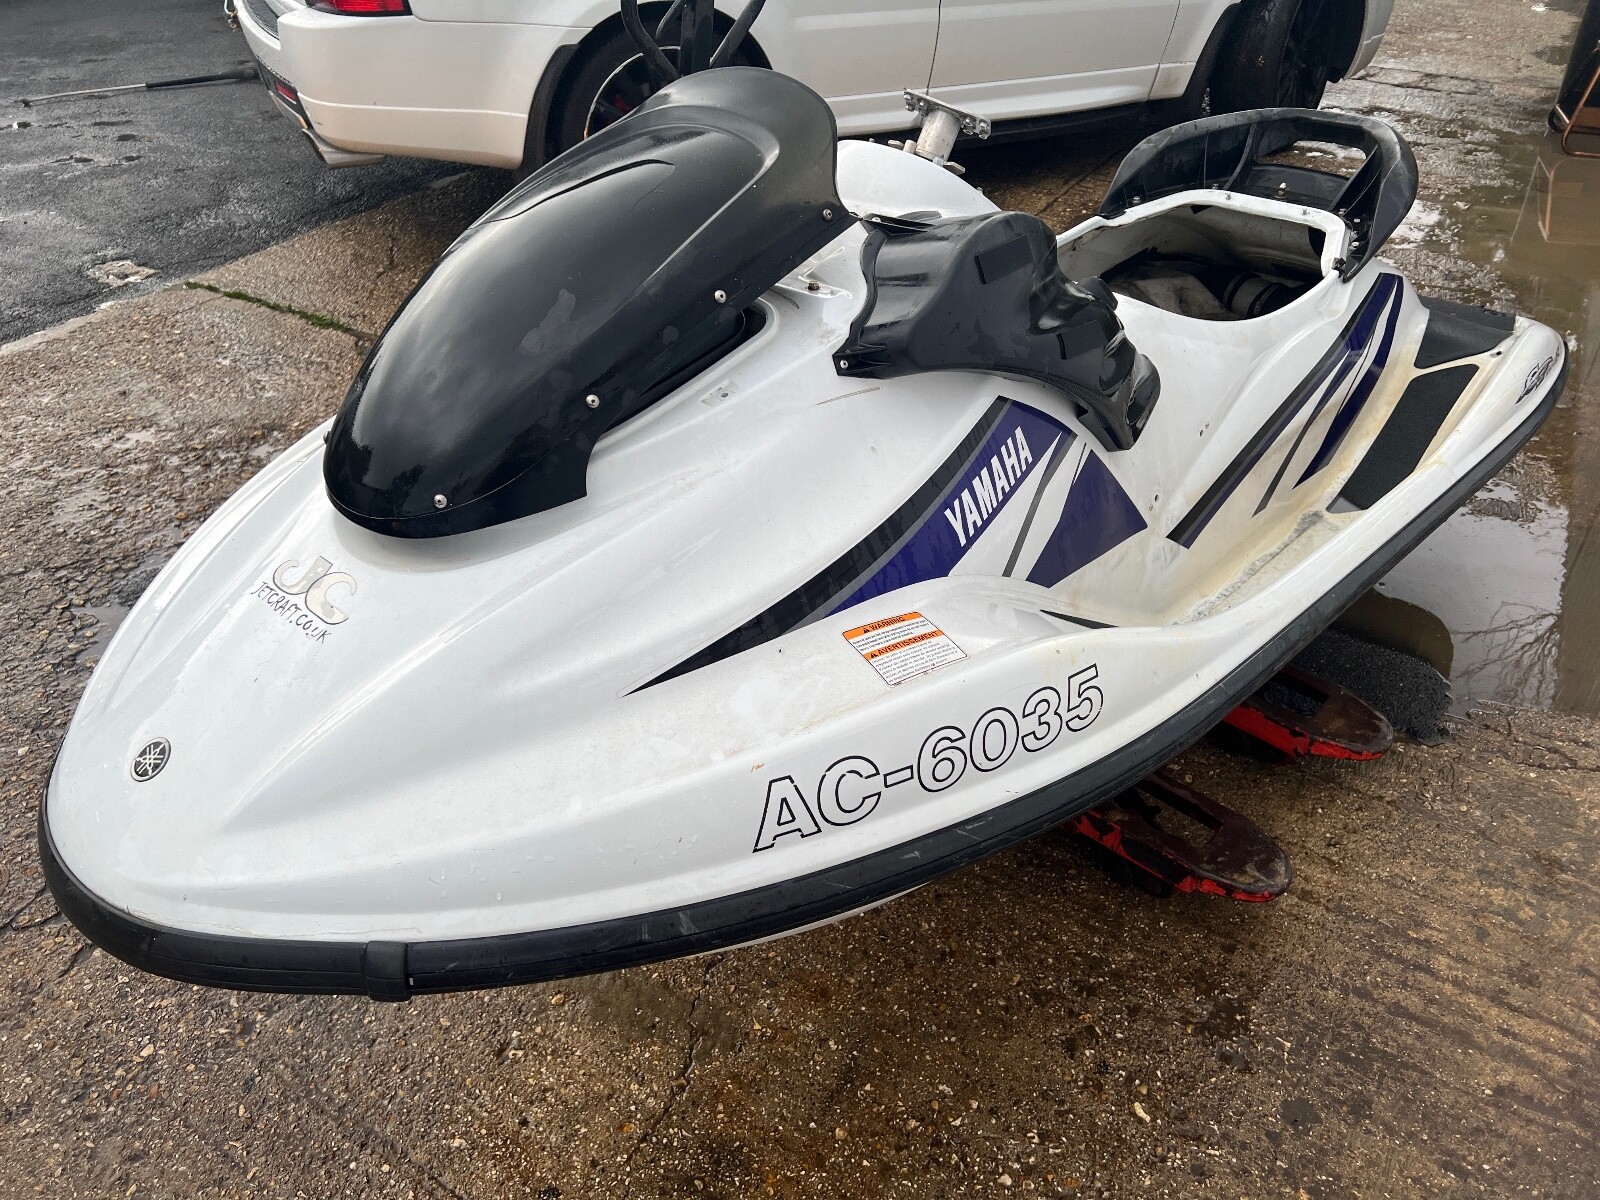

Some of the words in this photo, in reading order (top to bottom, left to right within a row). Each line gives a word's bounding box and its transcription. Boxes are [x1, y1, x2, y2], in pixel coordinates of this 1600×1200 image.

[943, 425, 1033, 548] YAMAHA
[871, 616, 906, 631] WARNING
[752, 663, 1104, 854] AC-6035
